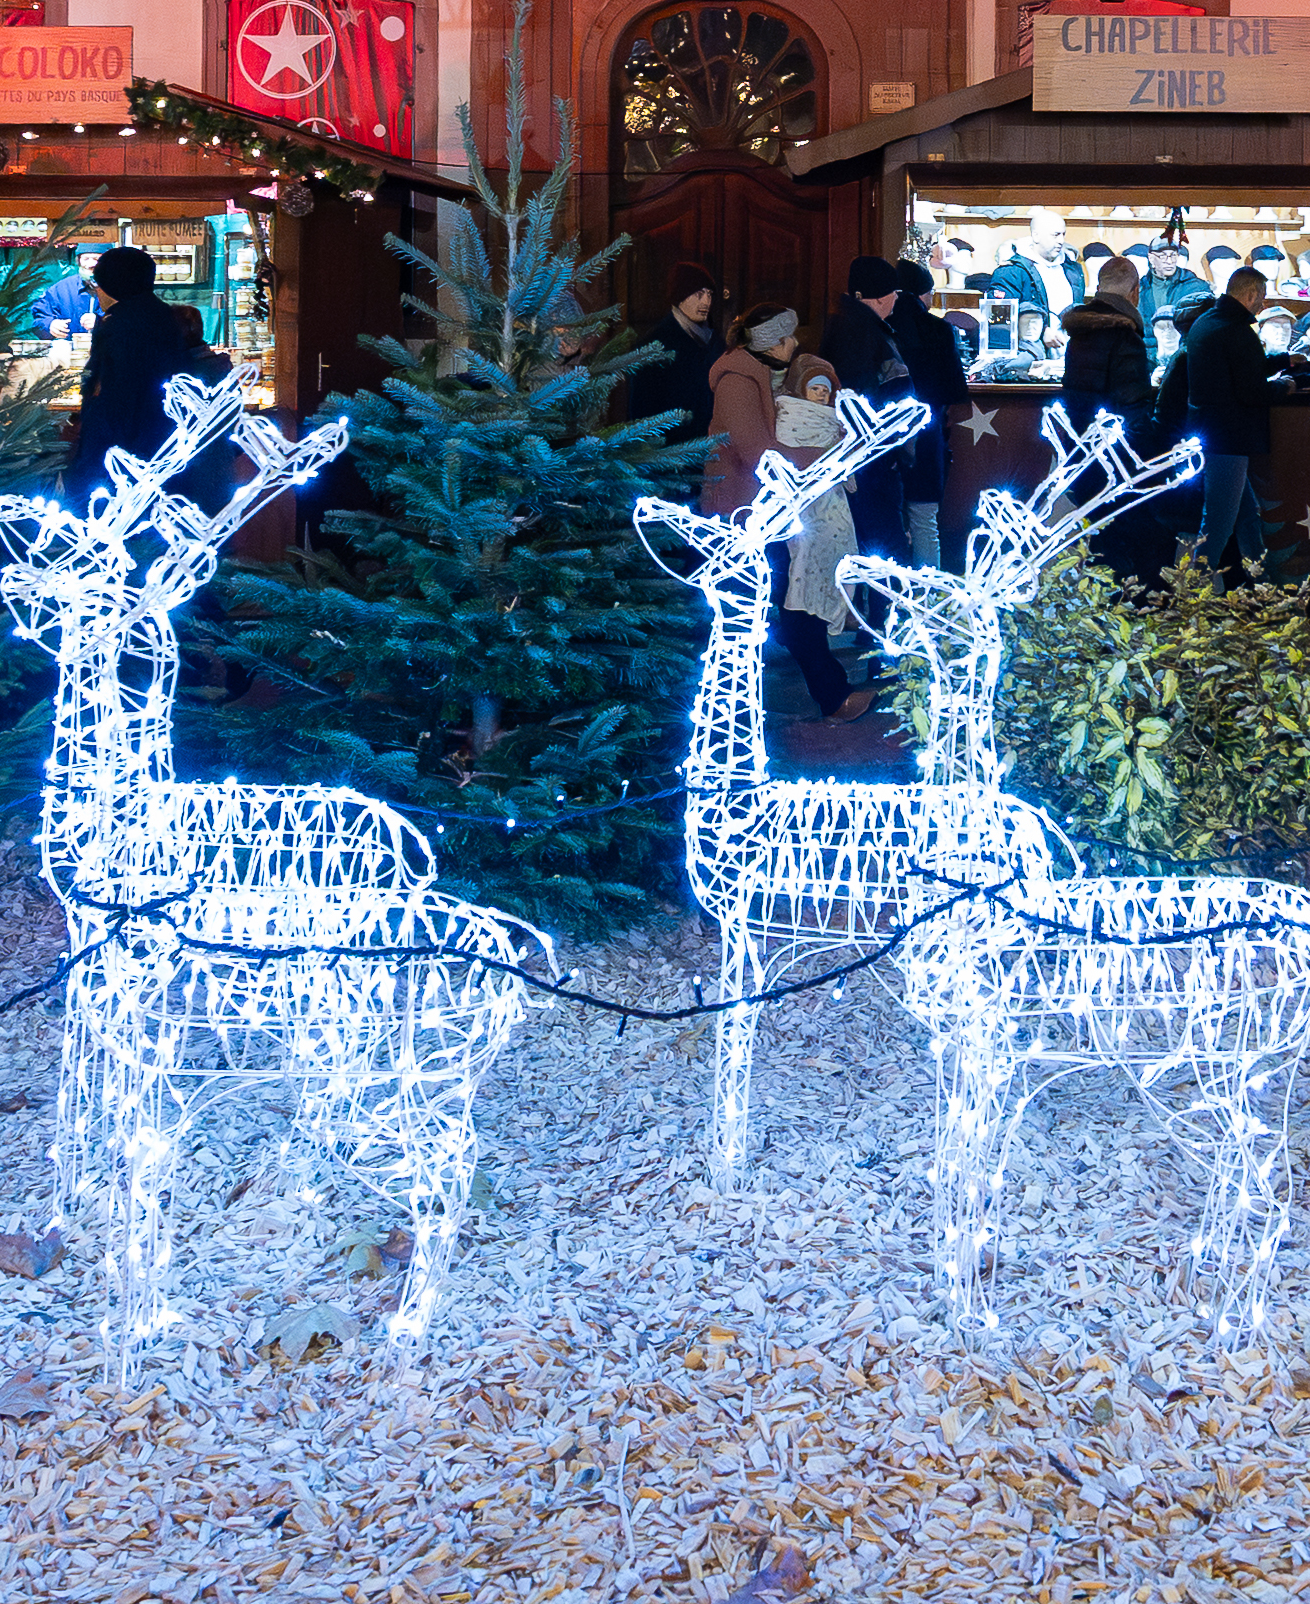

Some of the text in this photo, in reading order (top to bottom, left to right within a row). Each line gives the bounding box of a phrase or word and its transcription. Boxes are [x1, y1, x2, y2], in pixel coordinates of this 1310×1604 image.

[27, 90, 42, 104] DU
[46, 90, 76, 104] PAYS
[80, 89, 124, 104] BASQUE
